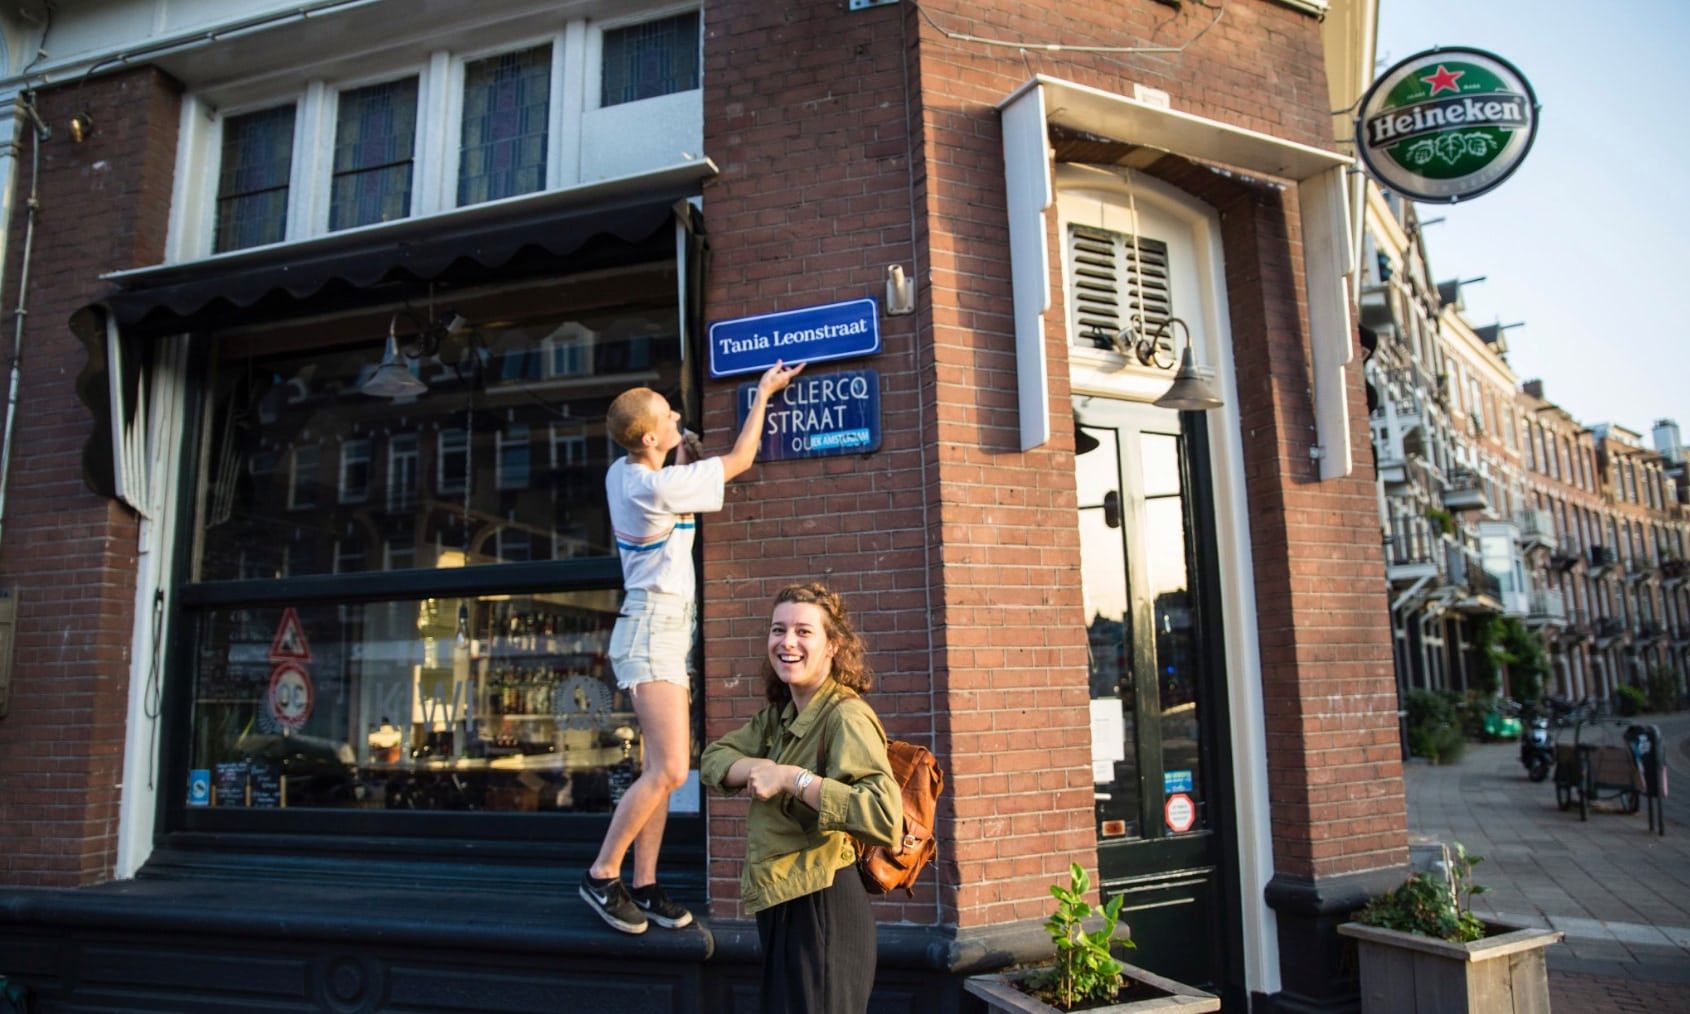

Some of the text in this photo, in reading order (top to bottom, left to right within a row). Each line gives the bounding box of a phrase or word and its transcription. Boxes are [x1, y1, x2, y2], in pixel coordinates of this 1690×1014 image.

[1374, 97, 1521, 142] Heineken
[719, 319, 868, 354] Tania Leonstraat
[783, 376, 869, 405] CLERCQ
[767, 405, 848, 434] STRAAT
